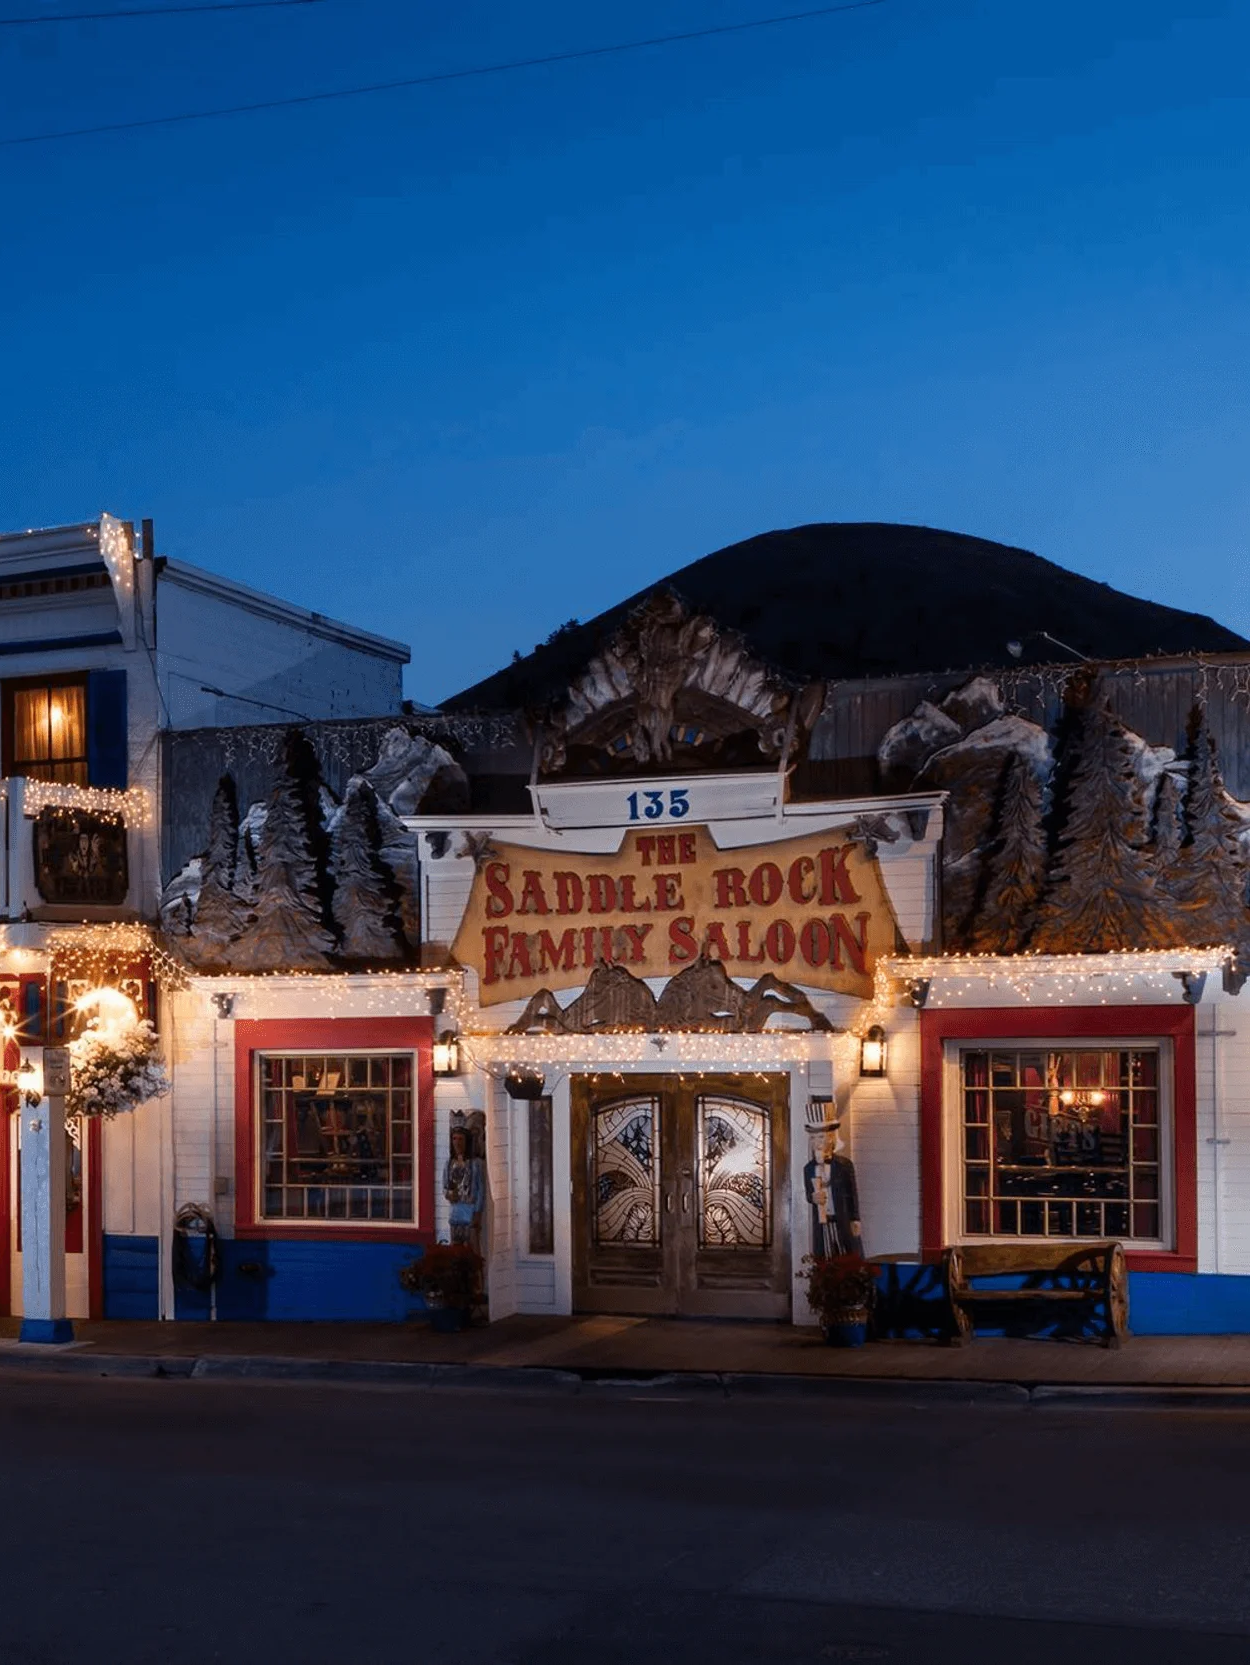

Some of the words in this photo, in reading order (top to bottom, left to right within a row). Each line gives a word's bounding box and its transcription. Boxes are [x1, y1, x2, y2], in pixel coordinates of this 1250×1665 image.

[626, 789, 690, 821] 135
[636, 833, 696, 867] THE
[483, 861, 685, 920] SADDLE
[712, 843, 862, 909] ROCK
[481, 922, 653, 986] FAMILY
[667, 911, 872, 977] SALOON
